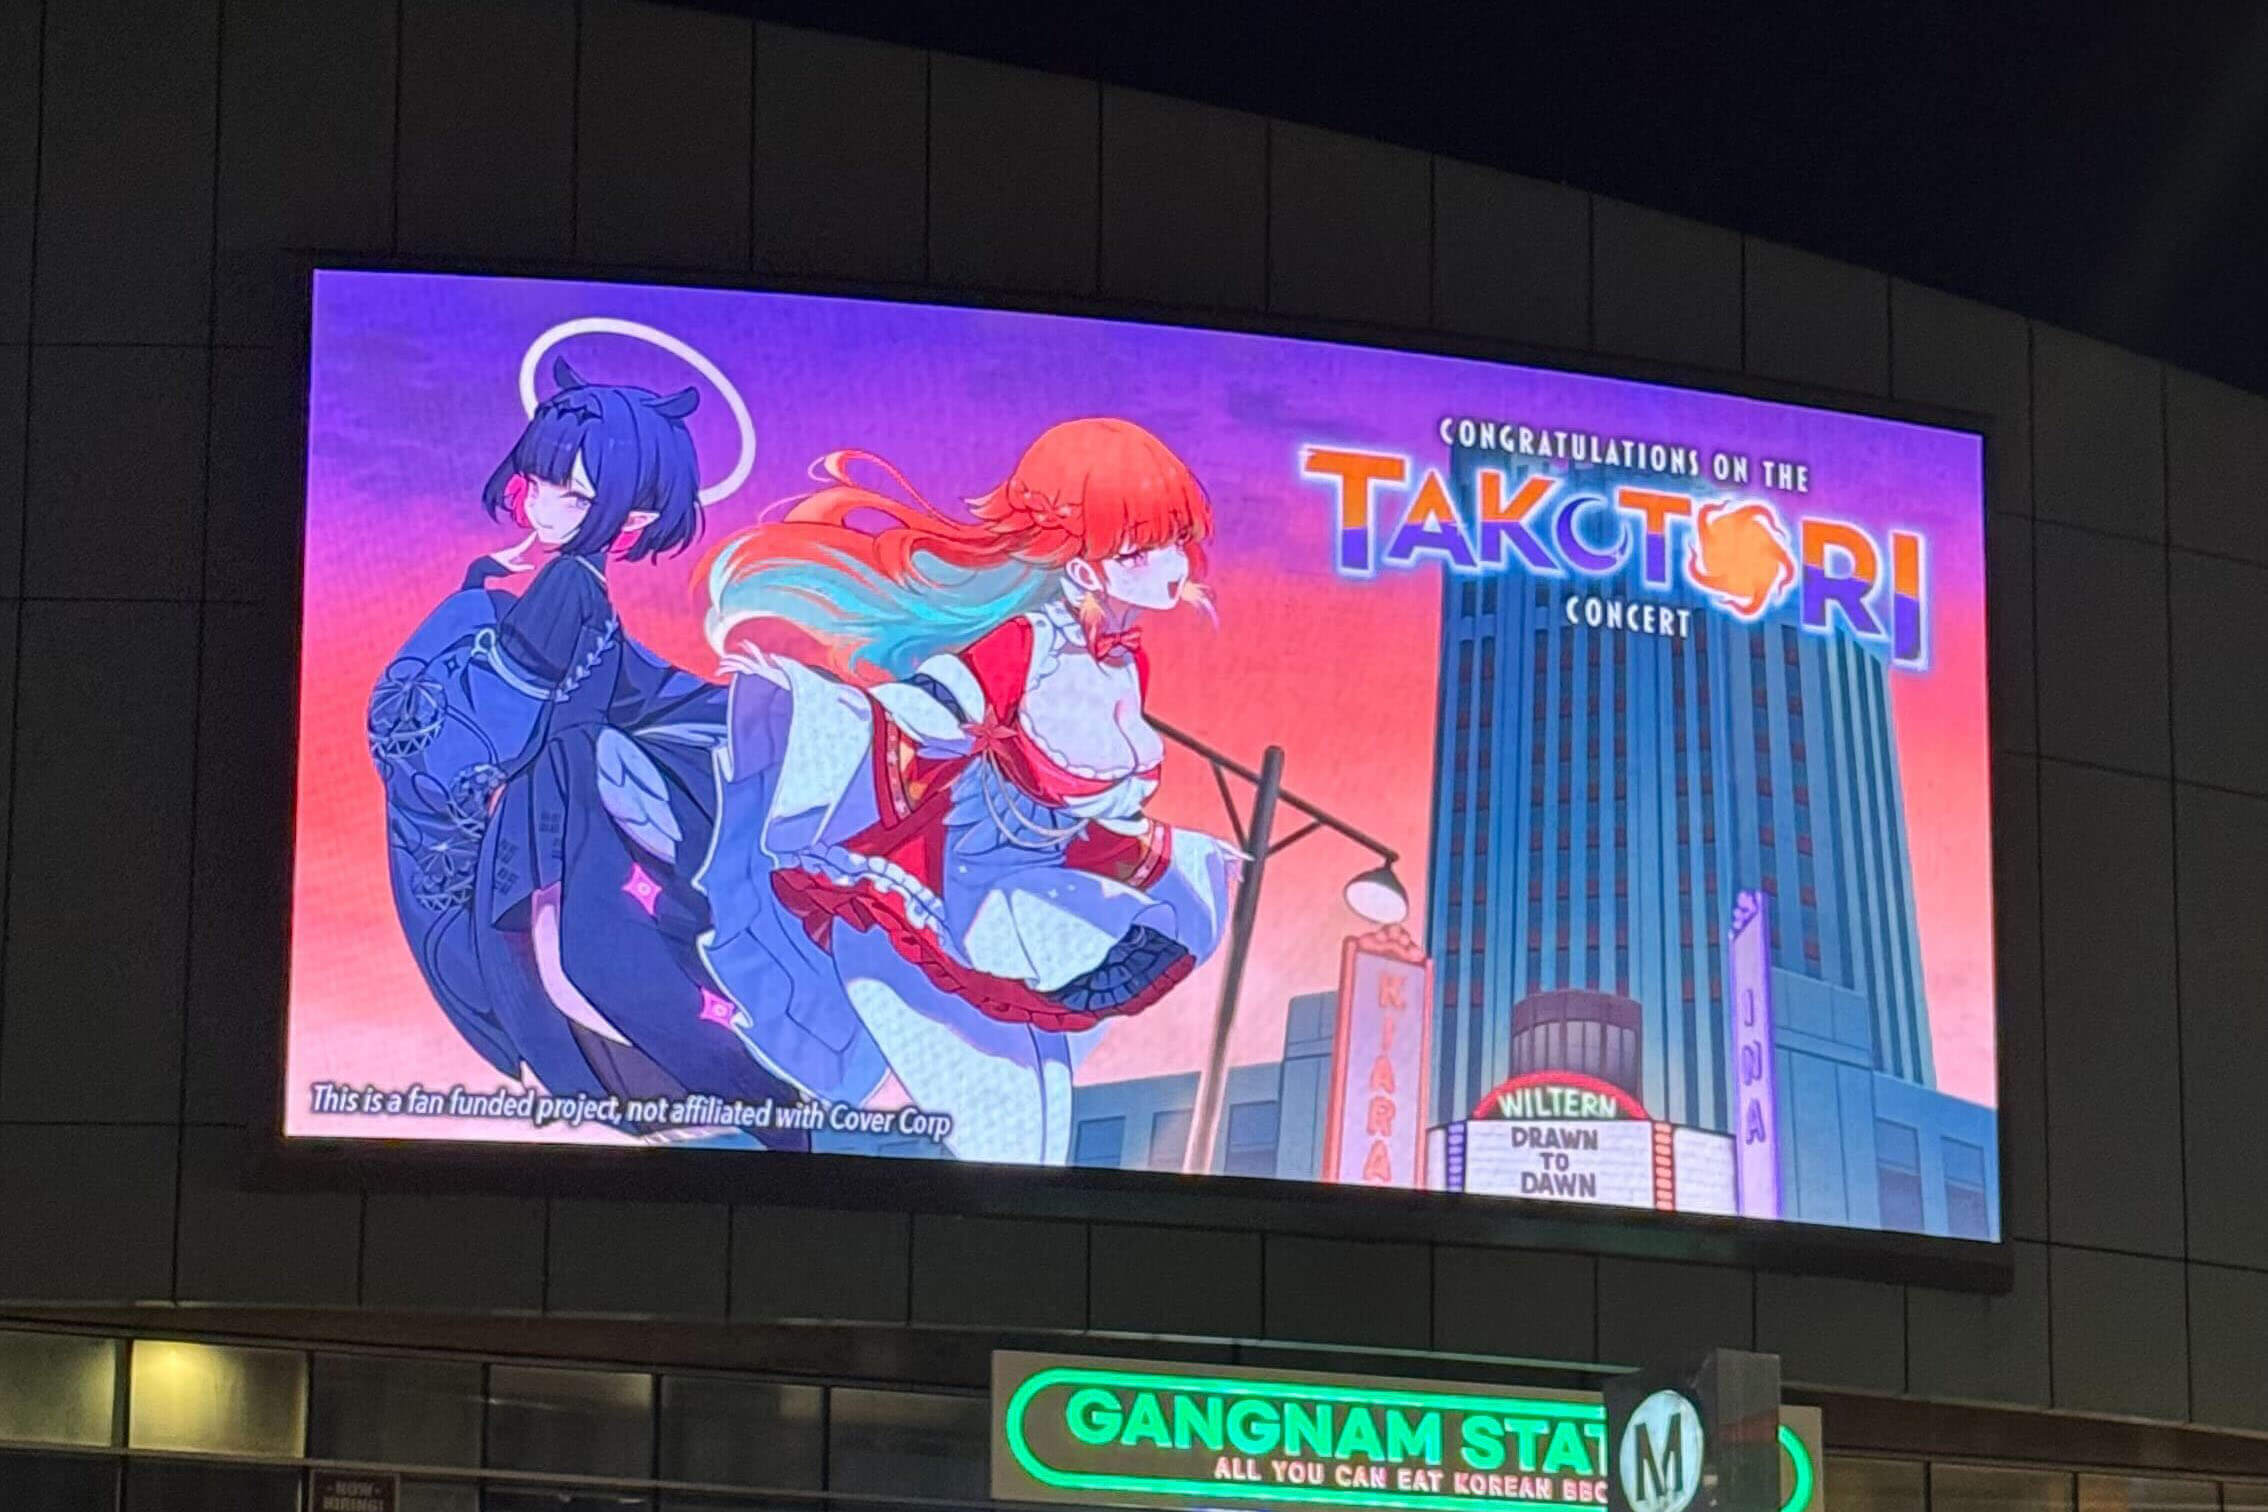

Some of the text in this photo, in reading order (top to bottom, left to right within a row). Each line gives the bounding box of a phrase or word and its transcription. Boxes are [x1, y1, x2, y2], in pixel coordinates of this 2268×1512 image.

[1439, 417, 1810, 493] CONGRATULATIONS ON THE
[1566, 595, 1691, 639] CONCERT
[1364, 974, 1406, 1182] KIARA
[311, 1083, 953, 1141] This is a fan funded project, not affiliated with Cover Corp
[1498, 1086, 1617, 1120] WILTERN
[1511, 1126, 1599, 1151] DRAWN
[1520, 1171, 1597, 1199] DAWN
[1540, 1153, 1570, 1173] TO
[1067, 1387, 1443, 1467] GANGNAM
[1214, 1456, 1262, 1482] ALL
[1271, 1459, 1327, 1488] YOU
[1335, 1465, 1388, 1490] CAN
[1397, 1470, 1446, 1493] EAT
[1453, 1472, 1553, 1500] KOREAN
